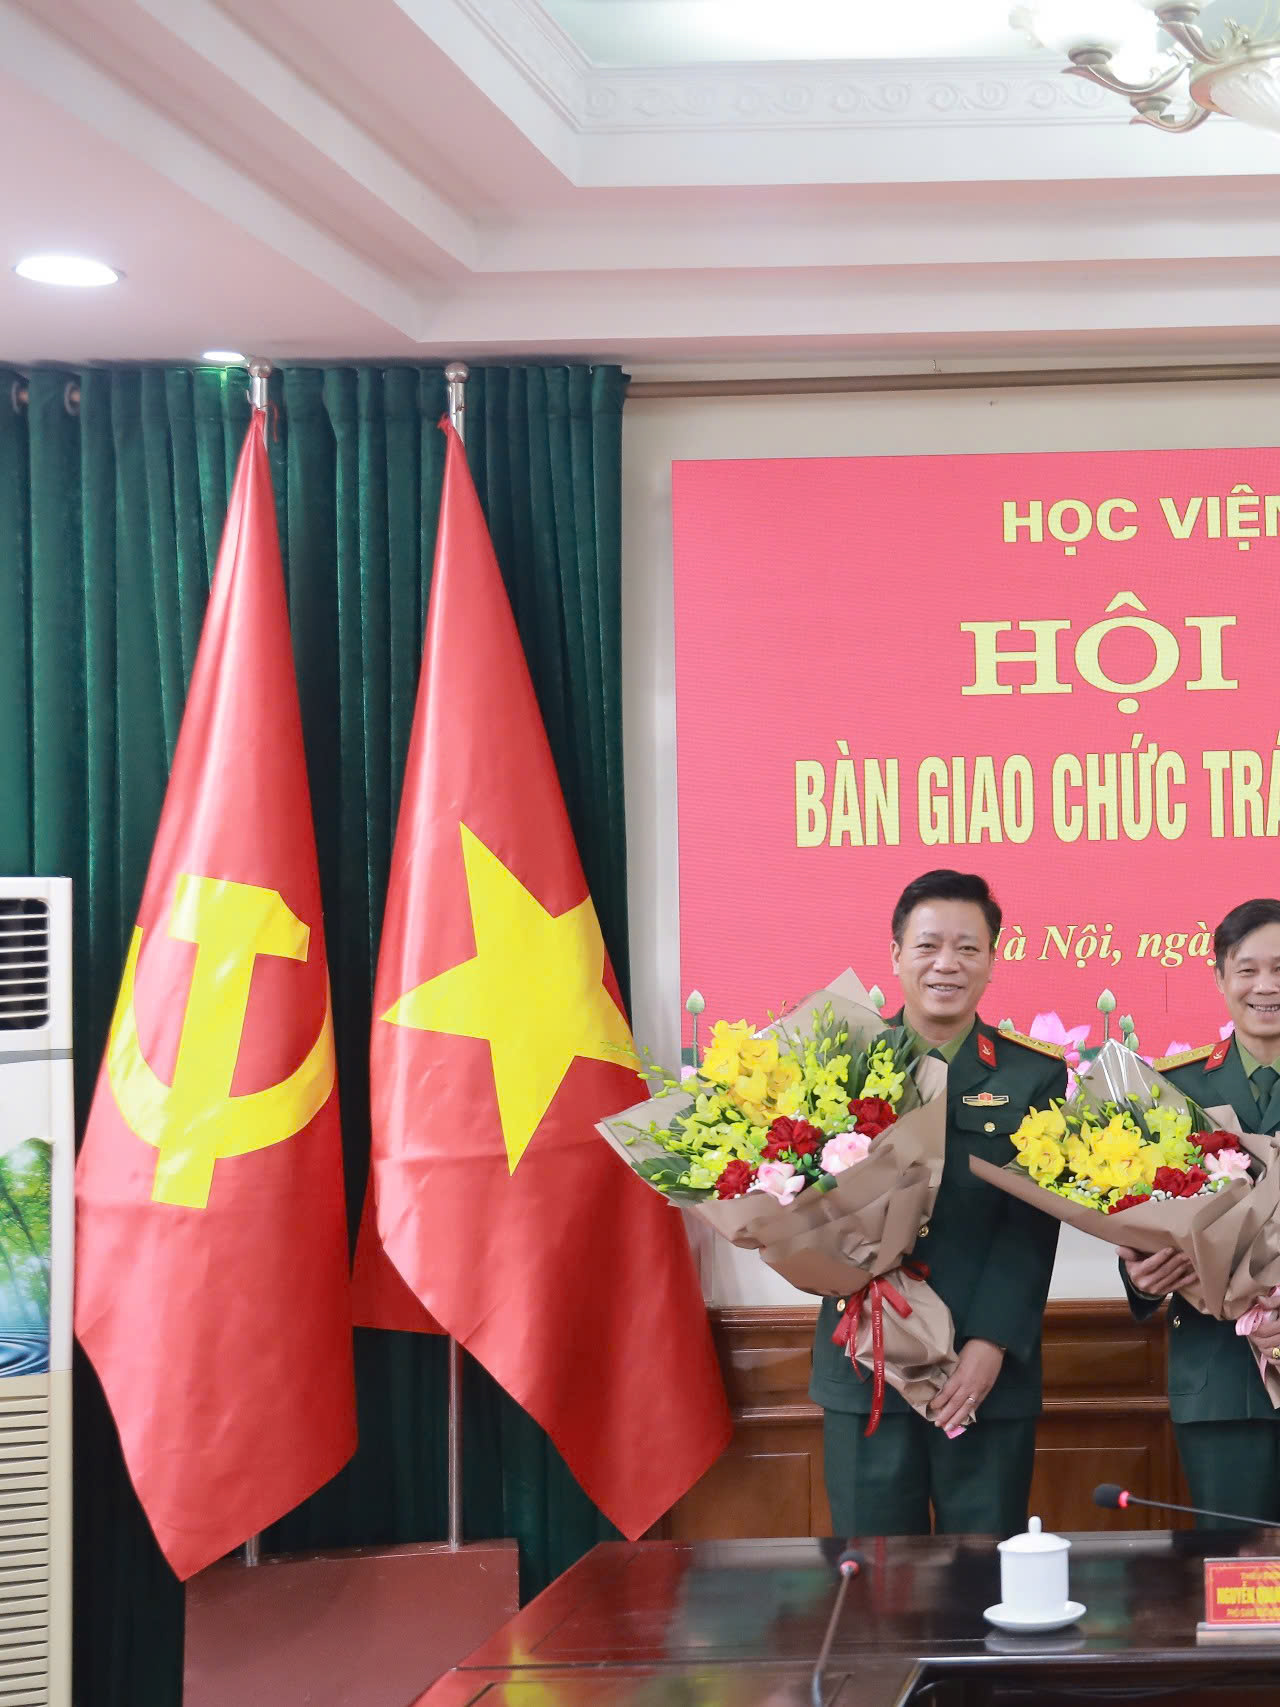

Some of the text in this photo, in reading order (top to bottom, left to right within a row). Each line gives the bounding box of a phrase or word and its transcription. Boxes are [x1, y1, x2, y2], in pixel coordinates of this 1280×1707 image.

[1003, 498, 1138, 556] HỌC
[960, 591, 1238, 714] HỘI
[795, 740, 900, 848] BÀN
[917, 753, 1034, 846] GIAO
[1052, 733, 1187, 844] CHỨC
[1036, 923, 1123, 969] Nội,
